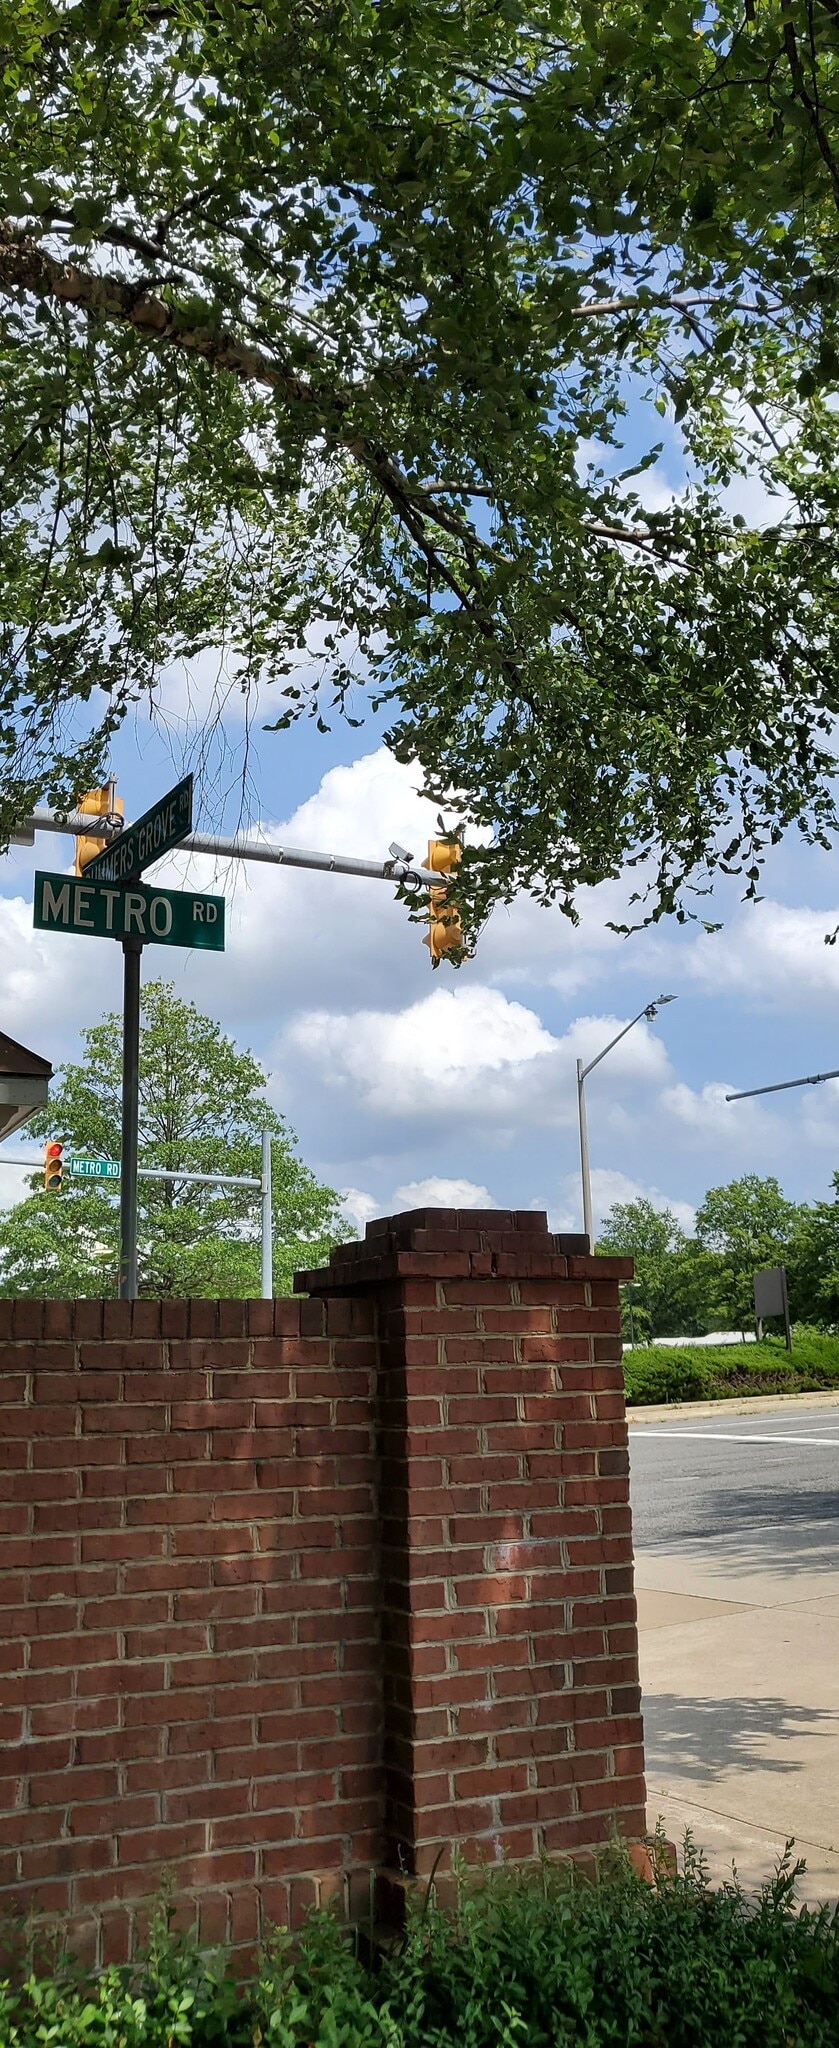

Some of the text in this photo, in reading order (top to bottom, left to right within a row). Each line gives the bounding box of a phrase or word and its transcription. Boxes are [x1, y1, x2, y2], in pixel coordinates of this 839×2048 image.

[85, 790, 189, 882] MMERS GROVE RD
[42, 880, 217, 937] METRO RD
[73, 1161, 118, 1176] METRO RD
